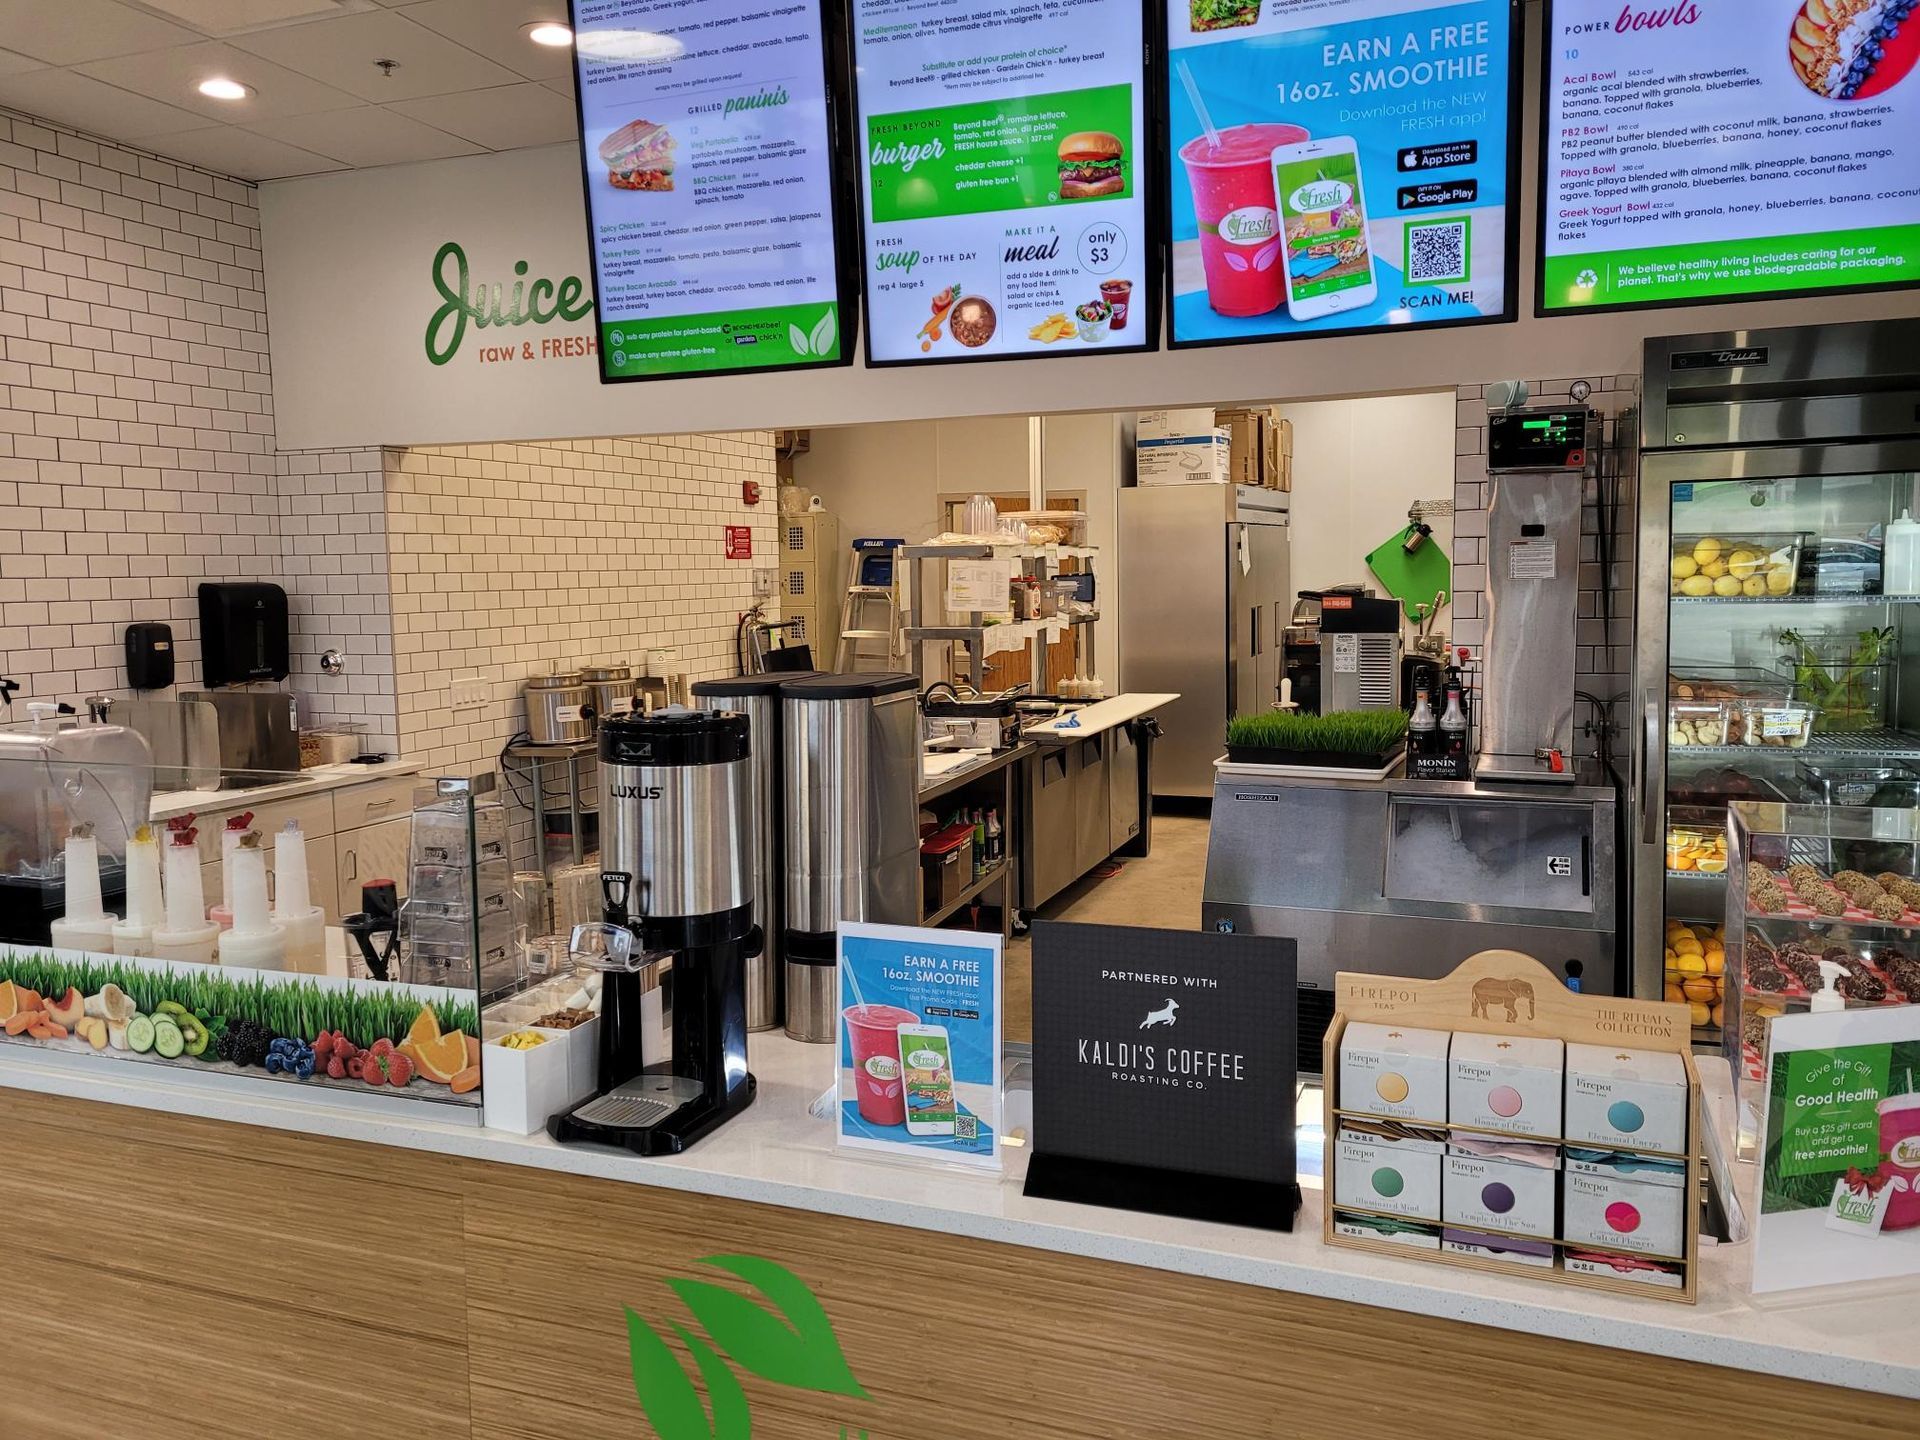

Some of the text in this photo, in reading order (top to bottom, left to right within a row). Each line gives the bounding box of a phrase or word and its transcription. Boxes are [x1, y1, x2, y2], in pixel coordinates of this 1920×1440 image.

[1565, 0, 1702, 35] POWER bowls
[1324, 22, 1488, 66] EARN A FREE
[1566, 49, 1578, 59] 10
[1277, 55, 1488, 103] 16oz. SMOOTHIE
[1592, 70, 1616, 81] Bowl
[688, 86, 790, 120] GRILLED paninis
[1340, 91, 1486, 122] Download the NEW
[870, 119, 941, 136] FRESH BEYOND
[1401, 108, 1486, 131] FRESH app!
[1562, 124, 1608, 137] PB2 Bowl
[872, 138, 945, 172] burger
[1422, 153, 1471, 166] App Store
[955, 162, 987, 171] cheddar
[1561, 164, 1615, 178] Pitaya Bowl
[956, 179, 978, 190] gluten
[979, 178, 994, 186] free
[1418, 189, 1473, 203] Google Play
[1559, 201, 1653, 218] Greek Yogurt Bowl
[1005, 227, 1032, 236] MAKE
[1089, 231, 1116, 244] only
[876, 238, 902, 247] FRESH
[1004, 236, 1059, 262] meal
[876, 250, 920, 273] soup
[939, 254, 954, 262] THE
[959, 252, 976, 261] DAY
[1091, 248, 1108, 264] $3
[1619, 264, 1634, 275] We
[1637, 264, 1676, 273] believe
[1679, 259, 1718, 270] healthy
[1722, 256, 1749, 266] living
[1753, 253, 1798, 263] includes
[1801, 250, 1837, 259] caring
[1840, 247, 1855, 256] for
[1618, 275, 1653, 287] planet.
[1657, 273, 1686, 282] That's
[1689, 271, 1711, 280] why
[1733, 266, 1753, 276] use
[1754, 261, 1839, 274] biodegradable
[1839, 256, 1905, 269] packaging.
[425, 242, 594, 365] Juice
[1008, 302, 1033, 310] organic
[1400, 291, 1473, 309] SCAN ME!
[480, 336, 599, 363] raw & FRESH
[610, 784, 660, 799] LUXUS
[904, 955, 979, 972] EARN A FREE
[883, 968, 979, 987] 16oz. SMOOTHIE
[1102, 970, 1218, 989] PARTNERED WITH
[1350, 986, 1418, 1004] FIREPOT
[1598, 1009, 1672, 1026] THE RITUALS
[1596, 1021, 1672, 1038] COLLECTION
[1079, 1040, 1244, 1080] KALDI'S COFFEE
[1348, 1052, 1379, 1066] Firepot
[1458, 1064, 1492, 1078] Firepot
[1806, 1059, 1873, 1083] Give the Gift
[1112, 1072, 1207, 1090] ROASTING CO.
[1576, 1078, 1612, 1092] Firepot
[1832, 1074, 1845, 1086] of
[1795, 1088, 1878, 1107] Good Health
[1795, 1127, 1810, 1136] Buy
[1821, 1123, 1835, 1134] $25
[1837, 1122, 1850, 1132] gift
[1852, 1120, 1872, 1130] card
[1812, 1135, 1828, 1145] and
[1830, 1135, 1844, 1145] get
[1344, 1146, 1375, 1159] Firepot
[1795, 1144, 1868, 1160] free smoothie!
[1451, 1160, 1485, 1174] Firepot
[1573, 1177, 1609, 1192] Firepot
